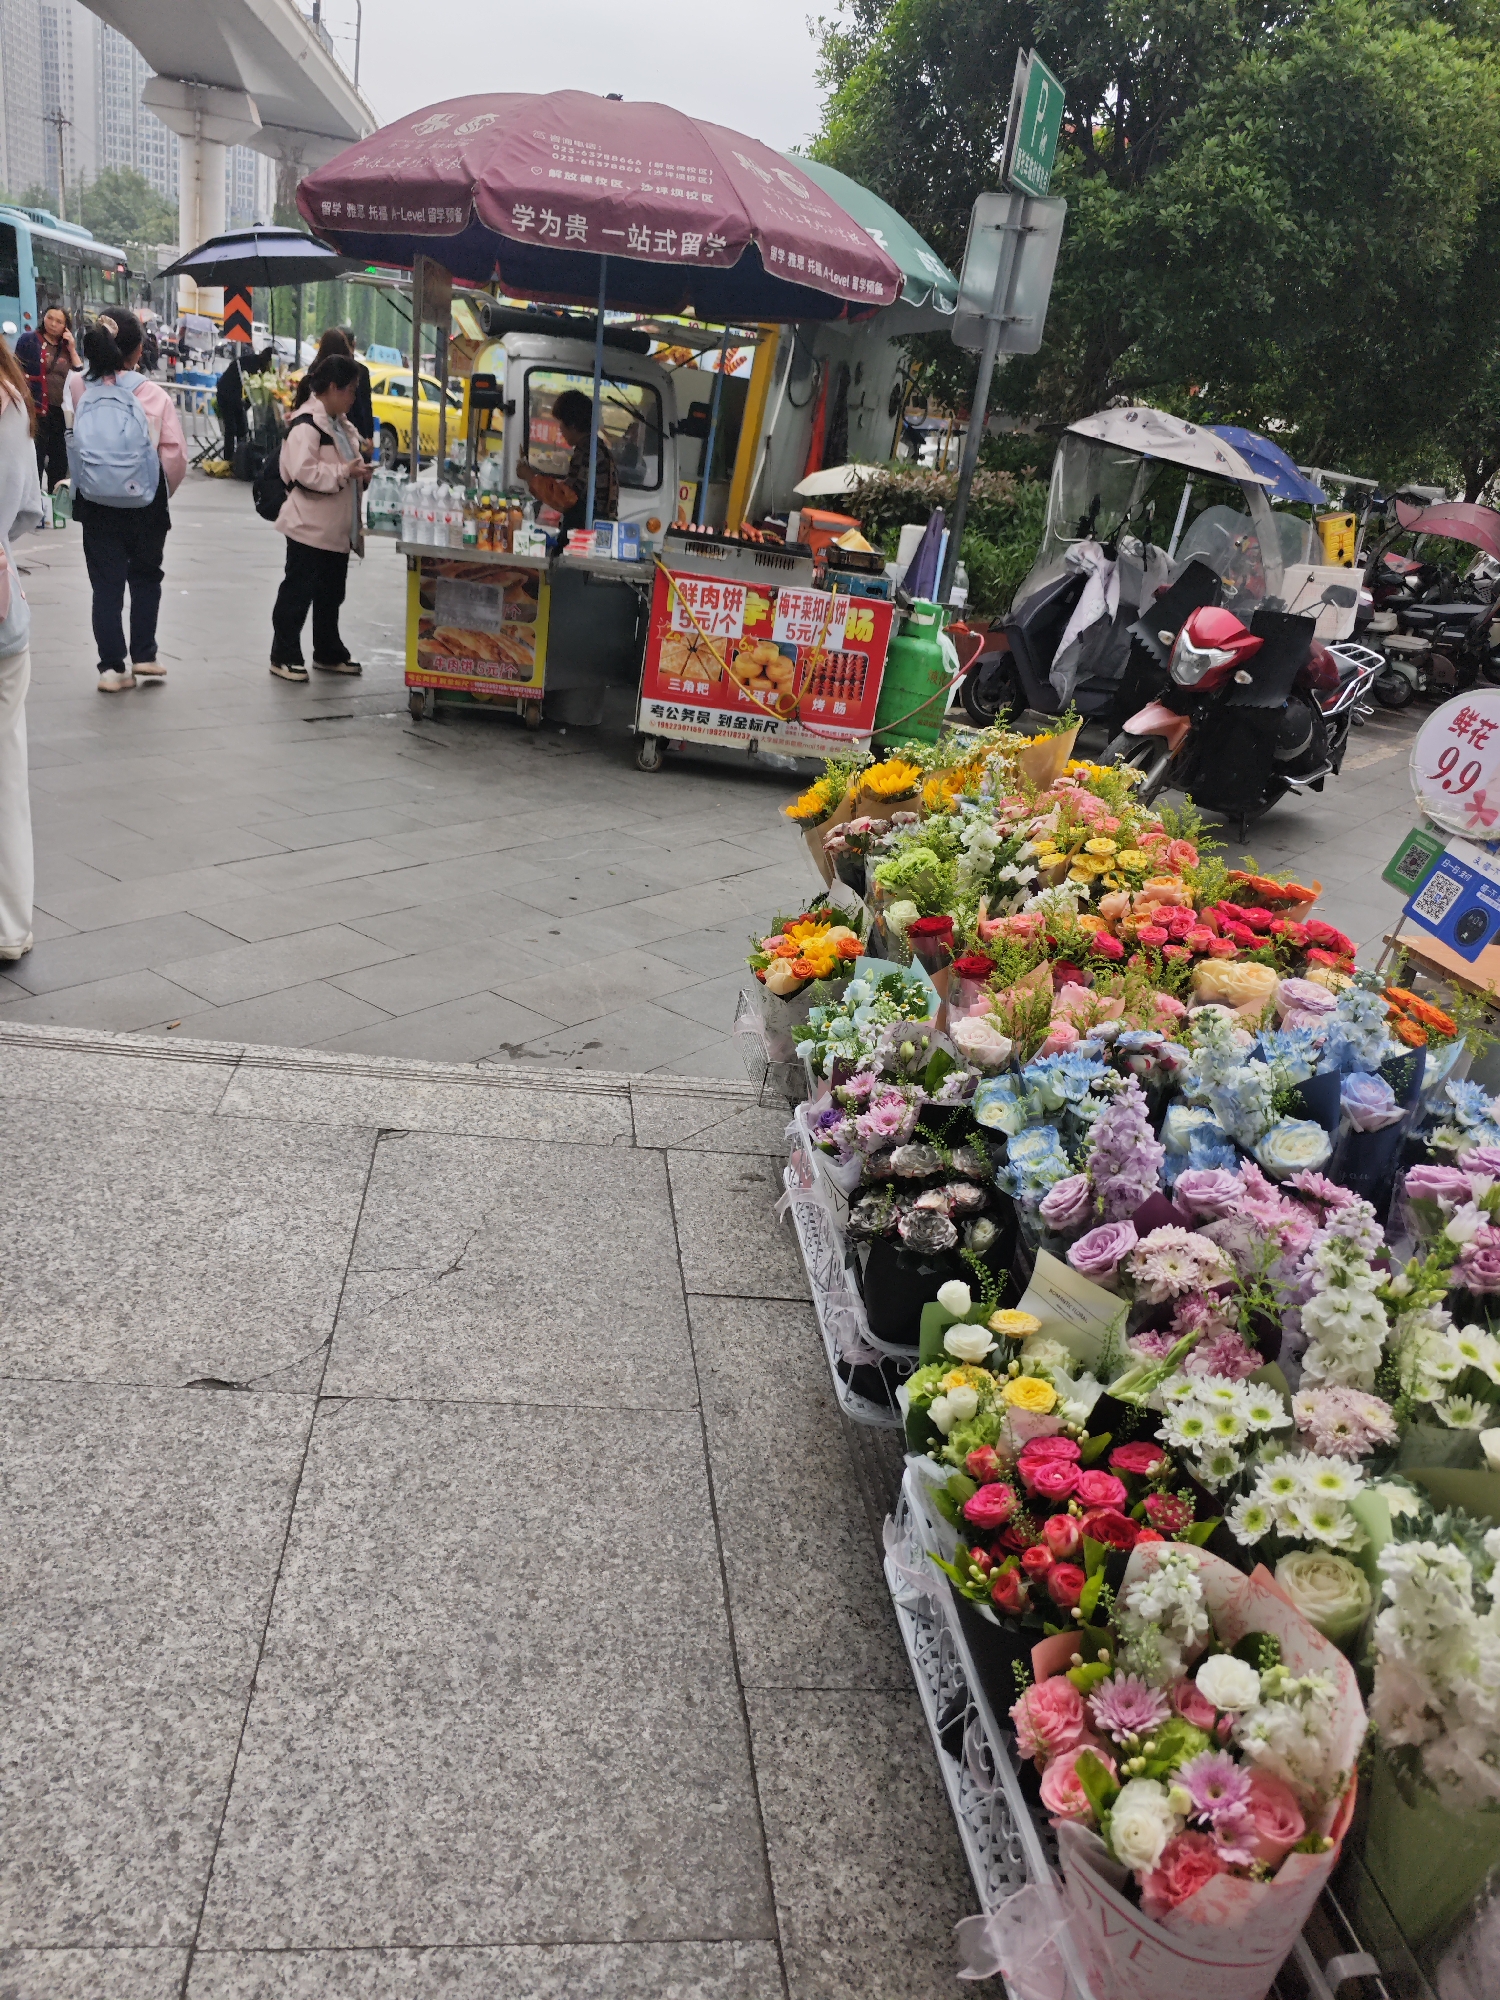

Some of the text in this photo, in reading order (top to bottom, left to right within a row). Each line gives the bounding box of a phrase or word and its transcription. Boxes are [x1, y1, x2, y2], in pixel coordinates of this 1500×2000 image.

[1031, 79, 1049, 147] P
[321, 201, 342, 217] 留学
[369, 204, 388, 221] 托福
[391, 207, 425, 222] A-Level
[511, 203, 589, 243] 学为贵
[602, 222, 728, 258] 一站式留学
[770, 245, 785, 265] 留学
[787, 251, 805, 271] 雅思
[823, 266, 850, 288] A-Level
[852, 275, 884, 296] 留学预备
[677, 582, 743, 612] 鲜肉饼
[779, 592, 847, 626] 梅干菜扣肉饼
[679, 609, 737, 634] 5元/个
[785, 622, 832, 645] 5元/个
[434, 656, 474, 673] 牛肉饼
[477, 659, 519, 681] 5元/个
[668, 677, 709, 696] 三角粑
[650, 704, 779, 734] 考公务员 到金标尺
[1447, 705, 1499, 750] 鲜花
[1426, 746, 1482, 795] 9.9
[1049, 1288, 1073, 1310] ROMANTIC
[1072, 1306, 1088, 1324] FLORAL
